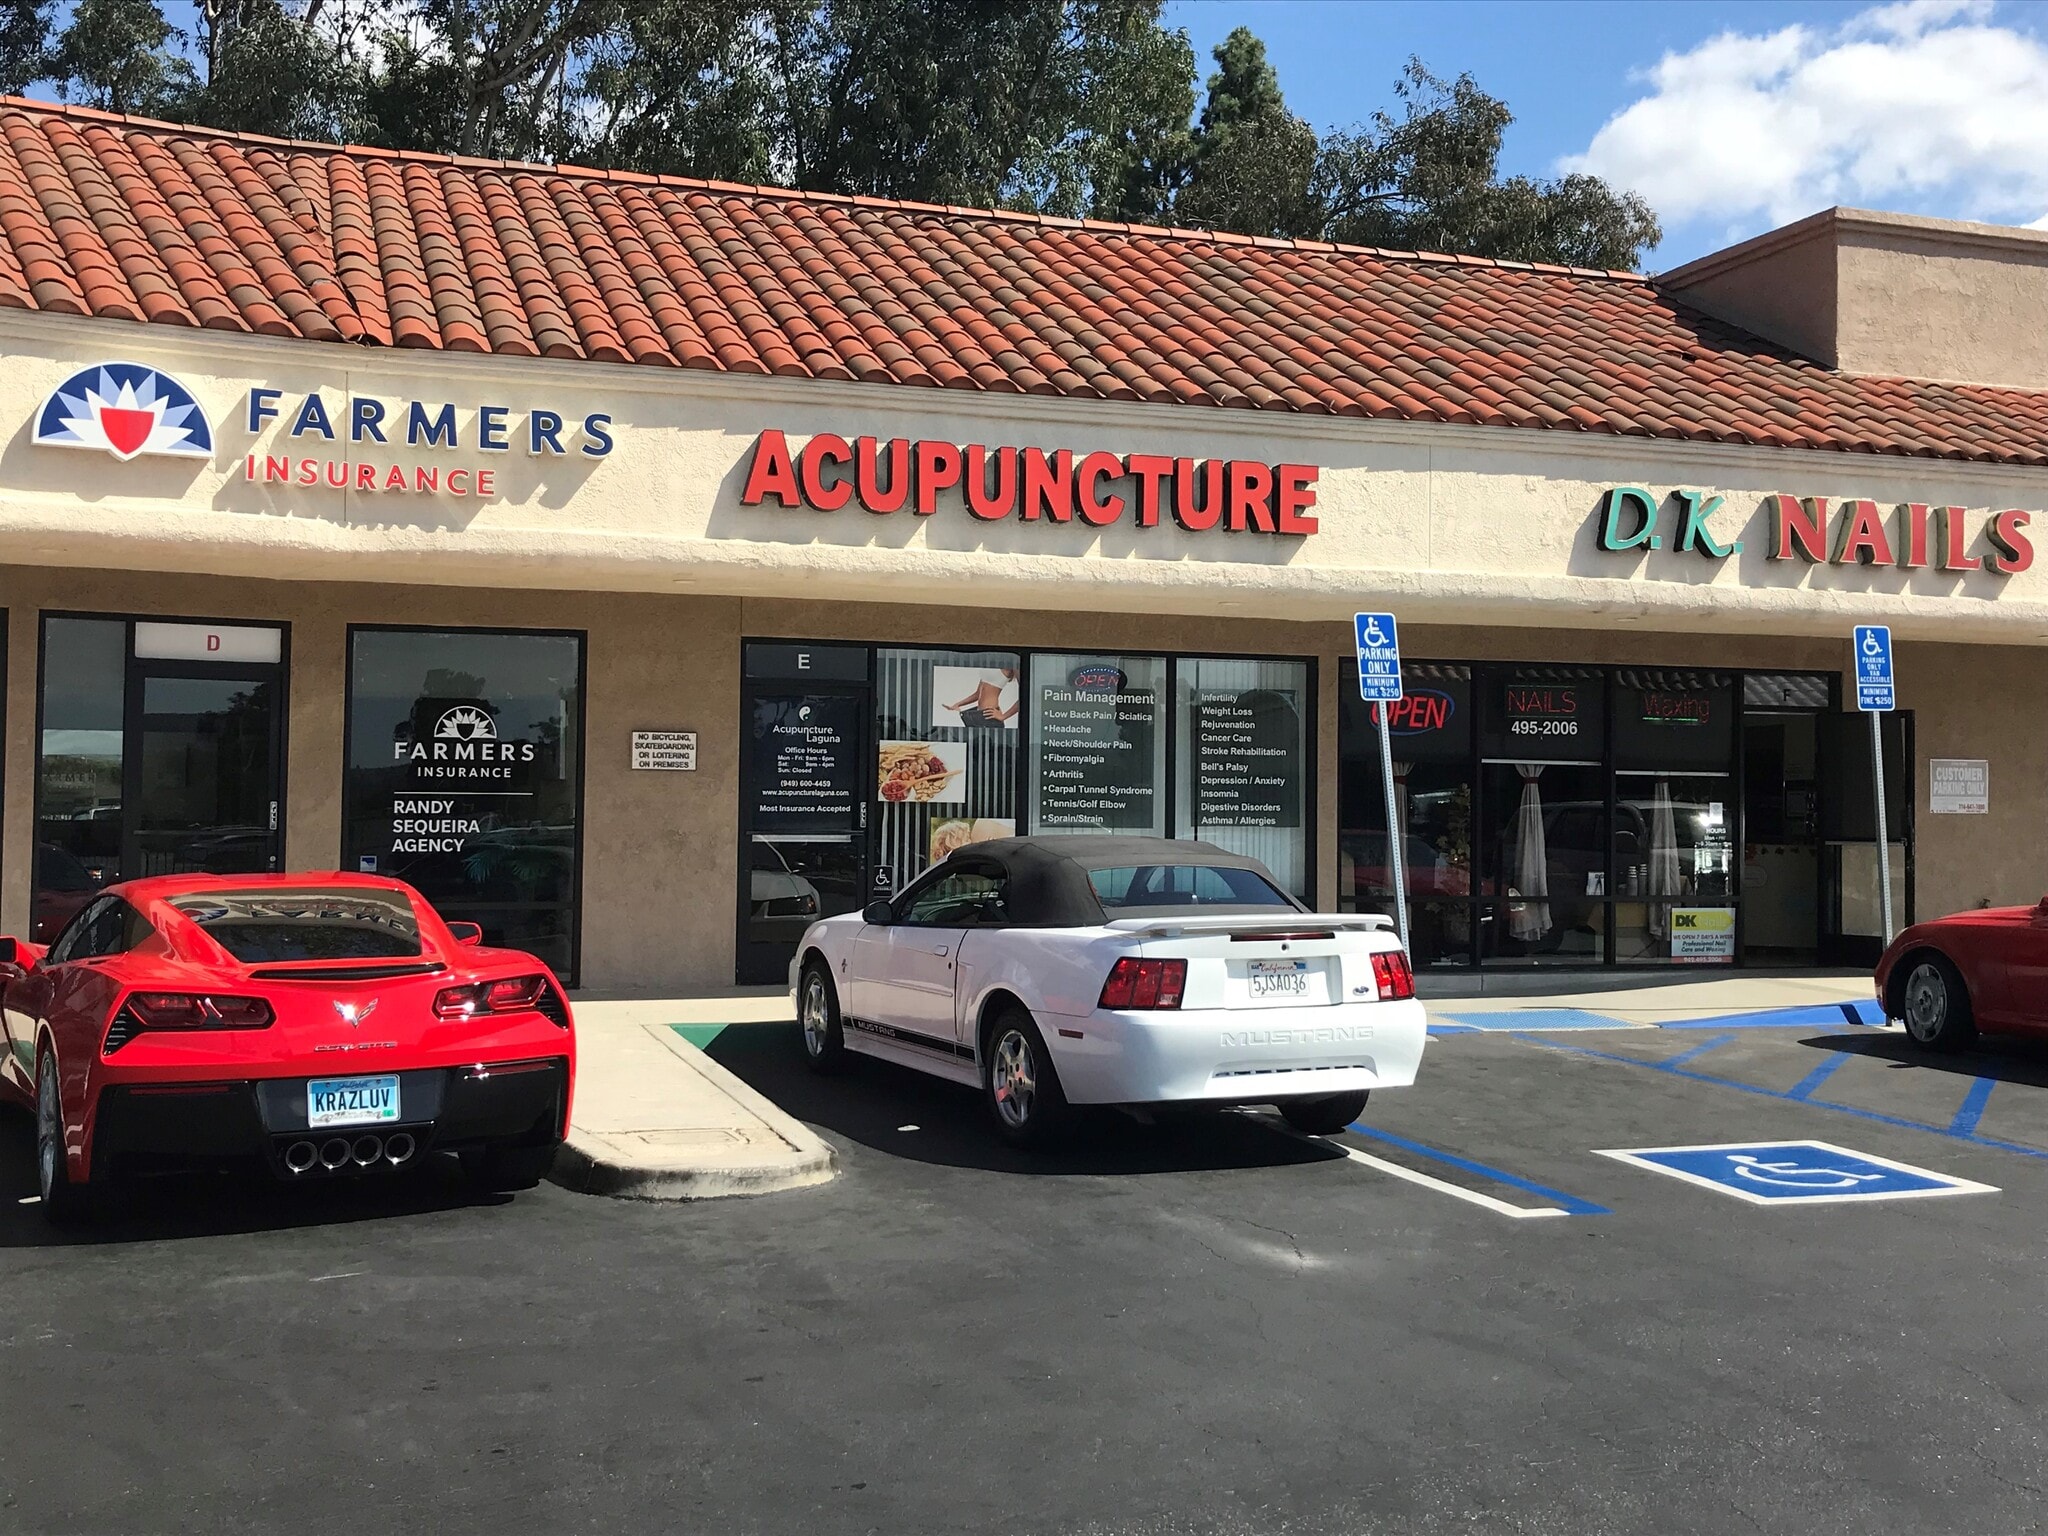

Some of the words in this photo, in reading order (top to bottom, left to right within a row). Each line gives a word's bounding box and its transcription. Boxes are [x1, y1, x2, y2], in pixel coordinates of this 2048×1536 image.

[248, 386, 615, 459] FARMERS
[246, 453, 498, 498] INSURANCE
[739, 428, 1320, 535] ACUPUNCTURE
[1766, 493, 2035, 575] NAILS
[207, 634, 221, 651] D
[1360, 647, 1397, 660] PARKING
[797, 653, 811, 670] E
[1368, 661, 1390, 674] ONLY
[1074, 674, 1119, 687] OPEN
[1366, 677, 1395, 686] MINIMUM
[1364, 687, 1379, 697] FINE
[1380, 687, 1399, 697] $250
[1783, 689, 1791, 701] F
[1863, 687, 1888, 695] MINIMUM
[1044, 689, 1072, 701] Pain
[1075, 690, 1155, 705] Management
[1201, 693, 1238, 703] Infertility
[1508, 690, 1577, 713] NAILS
[1049, 710, 1067, 718] Low
[1070, 710, 1091, 719] Back
[1093, 711, 1112, 720] Pain
[1118, 711, 1152, 721] Sciatica
[1201, 707, 1231, 716] Weight
[1233, 707, 1253, 716] Loss
[1371, 696, 1448, 728] OPEN
[772, 725, 833, 735] Acupuncture
[1049, 724, 1091, 734] Headache
[1201, 720, 1255, 730] Rejuvenation
[1511, 720, 1578, 735] 495-2006
[806, 733, 841, 744] Laguna
[1201, 733, 1231, 742] Cancer
[1233, 734, 1252, 742] Care
[634, 742, 695, 750] SKATEBOARDING
[1048, 739, 1110, 749] Neck/Shoulder
[1113, 741, 1132, 749] Pain
[394, 742, 535, 761] FARMERS
[1201, 746, 1229, 755] Stroke
[1230, 747, 1287, 756] Rehabilitation
[1048, 754, 1105, 765] Fibromyalgia
[417, 767, 512, 778] INSURANCE
[1201, 762, 1224, 771] Bell's
[1226, 763, 1249, 773] Palsy
[1049, 770, 1084, 779] Arthritis
[1936, 767, 1983, 781] CUSTOMER
[780, 780, 798, 788] (949)
[1201, 776, 1248, 785] Depression
[1254, 777, 1285, 787] Anxiety
[762, 789, 849, 797] www.acupuncturelaguna.com
[1048, 785, 1076, 794] Carpal
[1078, 785, 1108, 794] Tunnel
[1109, 786, 1153, 796] Syndrome
[1201, 789, 1239, 798] Insomnia
[1933, 781, 1966, 795] PARKING
[1967, 781, 1985, 795] ONLY
[393, 800, 454, 814] RANDY
[759, 804, 778, 812] Most
[816, 805, 851, 813] Accepted
[1048, 799, 1098, 808] Tennis/Golf
[1099, 800, 1126, 809] Elbow
[1200, 802, 1240, 812] Digestive
[1241, 803, 1281, 812] Disorders
[1047, 814, 1104, 824] Sprain/Strain
[1201, 816, 1233, 825] Asthma
[1239, 817, 1277, 827] Allergies
[392, 819, 480, 834] SEQUEIRA
[391, 838, 465, 853] AGENCY
[1675, 914, 1697, 927] DK
[1260, 962, 1296, 974] California
[1253, 973, 1306, 992] 5JSA036
[858, 1020, 896, 1037] MUSTANG
[1220, 1026, 1374, 1047] MUSTANG
[315, 1088, 390, 1112] KRAZLUV
